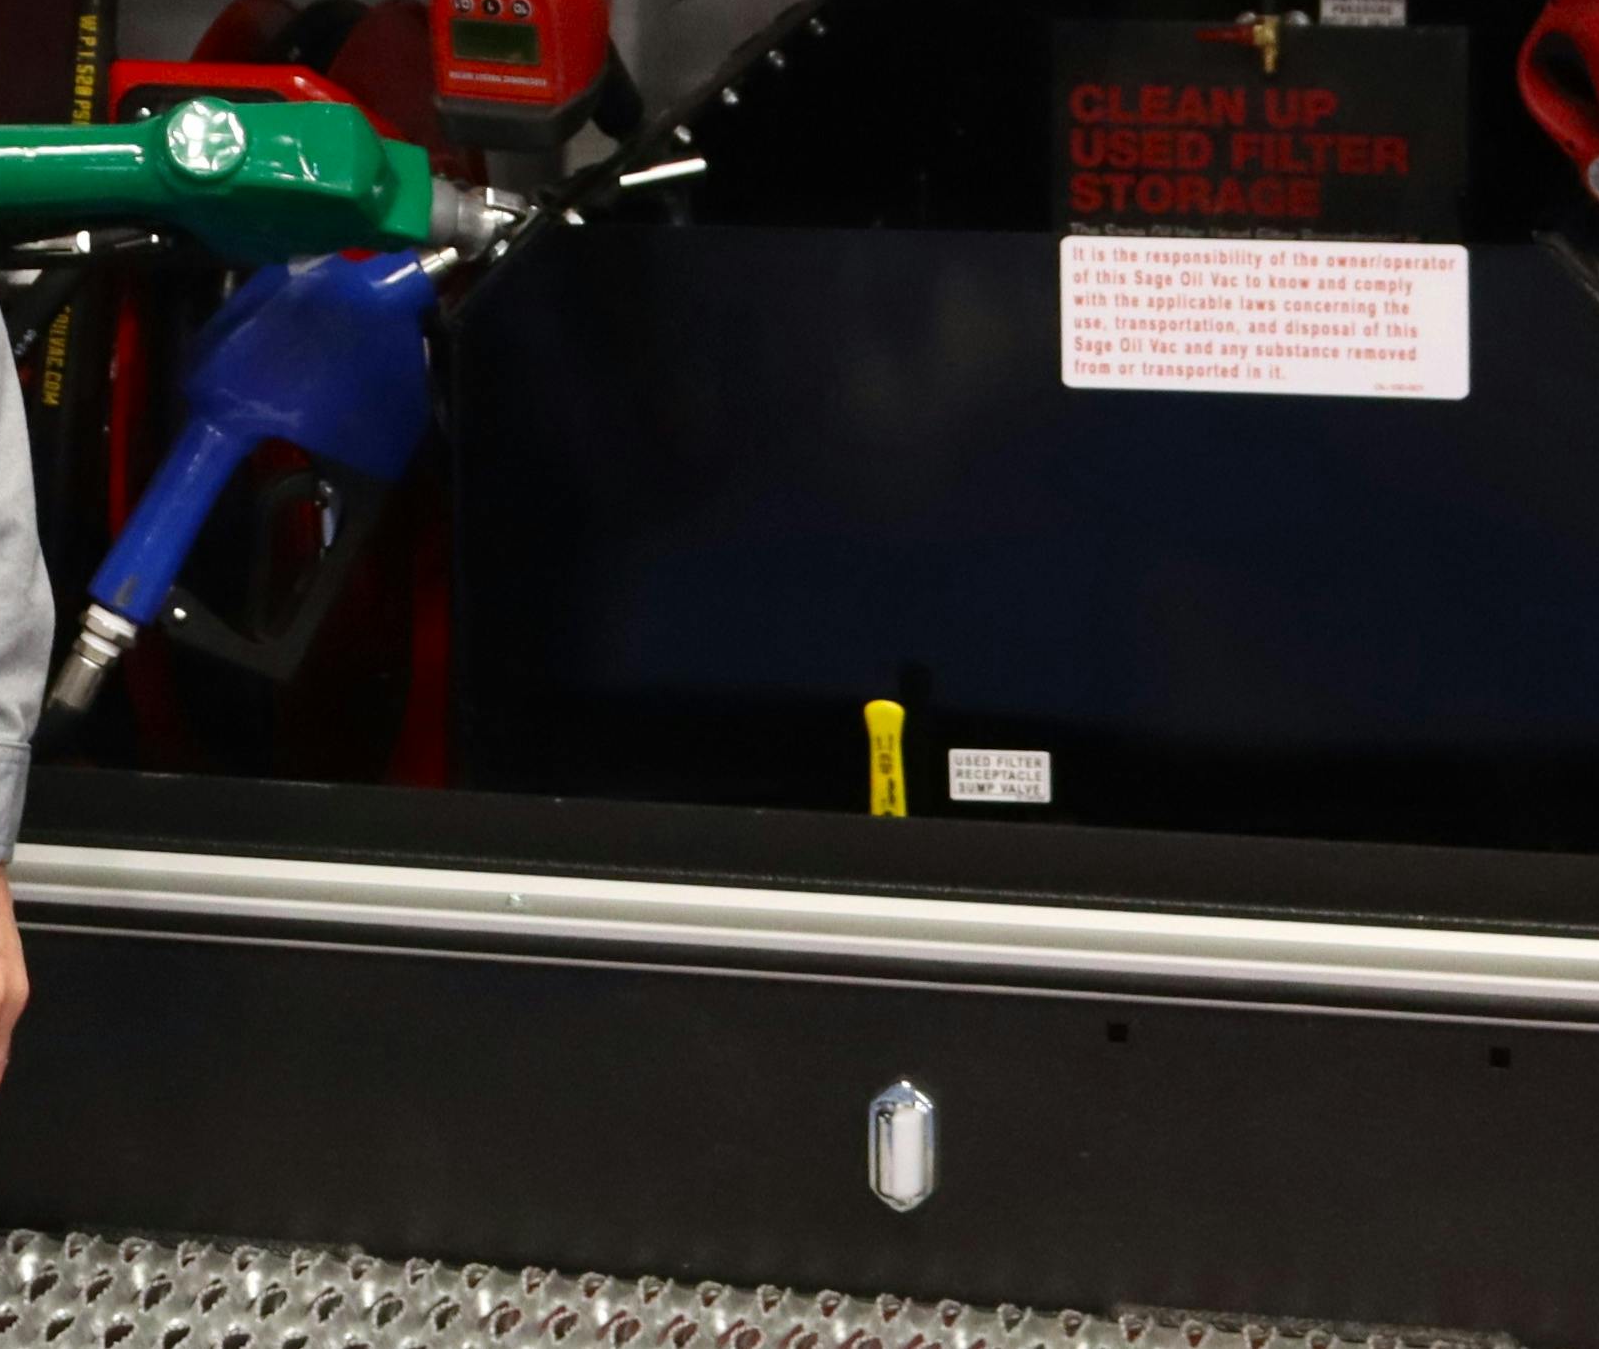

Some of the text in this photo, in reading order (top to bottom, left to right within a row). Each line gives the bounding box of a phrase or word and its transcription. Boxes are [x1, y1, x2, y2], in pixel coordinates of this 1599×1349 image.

[1069, 84, 1339, 128] CLEAN UP
[1069, 128, 1410, 176] USED FILTER
[1069, 172, 1322, 217] STORAGE
[1073, 247, 1456, 271] It is the responsibility of the owner/operator
[1073, 270, 1413, 296] of this Sage Oil Vac to know and comply
[1074, 292, 1409, 317] with the applicable laws concerning the
[1074, 316, 1418, 339] use, transportation, and disposal of this
[1074, 336, 1417, 361] Sage Oil Vac and any substance removed
[1074, 360, 1286, 380] from or transported in it.
[955, 755, 1043, 769] USED FILTER
[956, 769, 1043, 782] RECEPTACLE
[1001, 783, 1042, 796] VALVE
